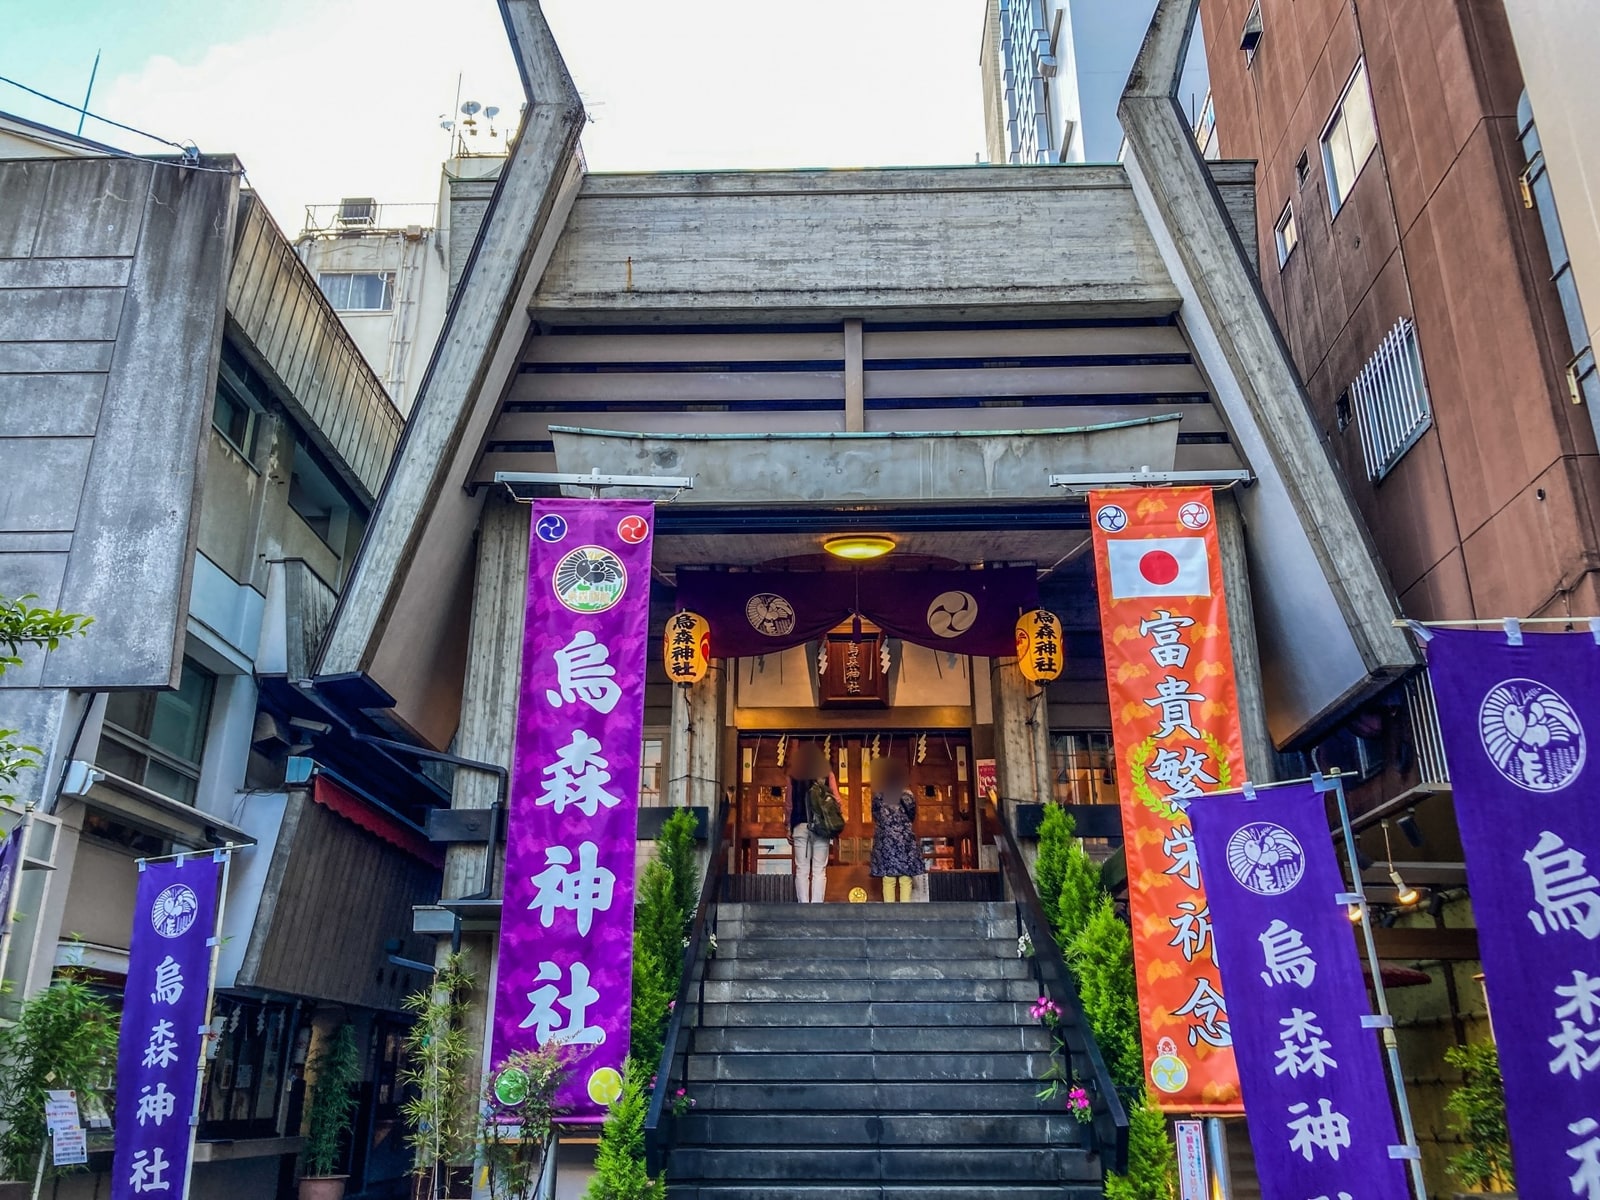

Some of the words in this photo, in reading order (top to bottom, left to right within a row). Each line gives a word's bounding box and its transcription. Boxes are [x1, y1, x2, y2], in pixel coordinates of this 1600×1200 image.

[671, 613, 697, 677] 烏森神社
[1034, 610, 1057, 673] 烏森神社
[518, 629, 622, 1046] 烏森神社
[129, 955, 185, 1194] 烏森神社
[1257, 918, 1353, 1200] 烏森神
